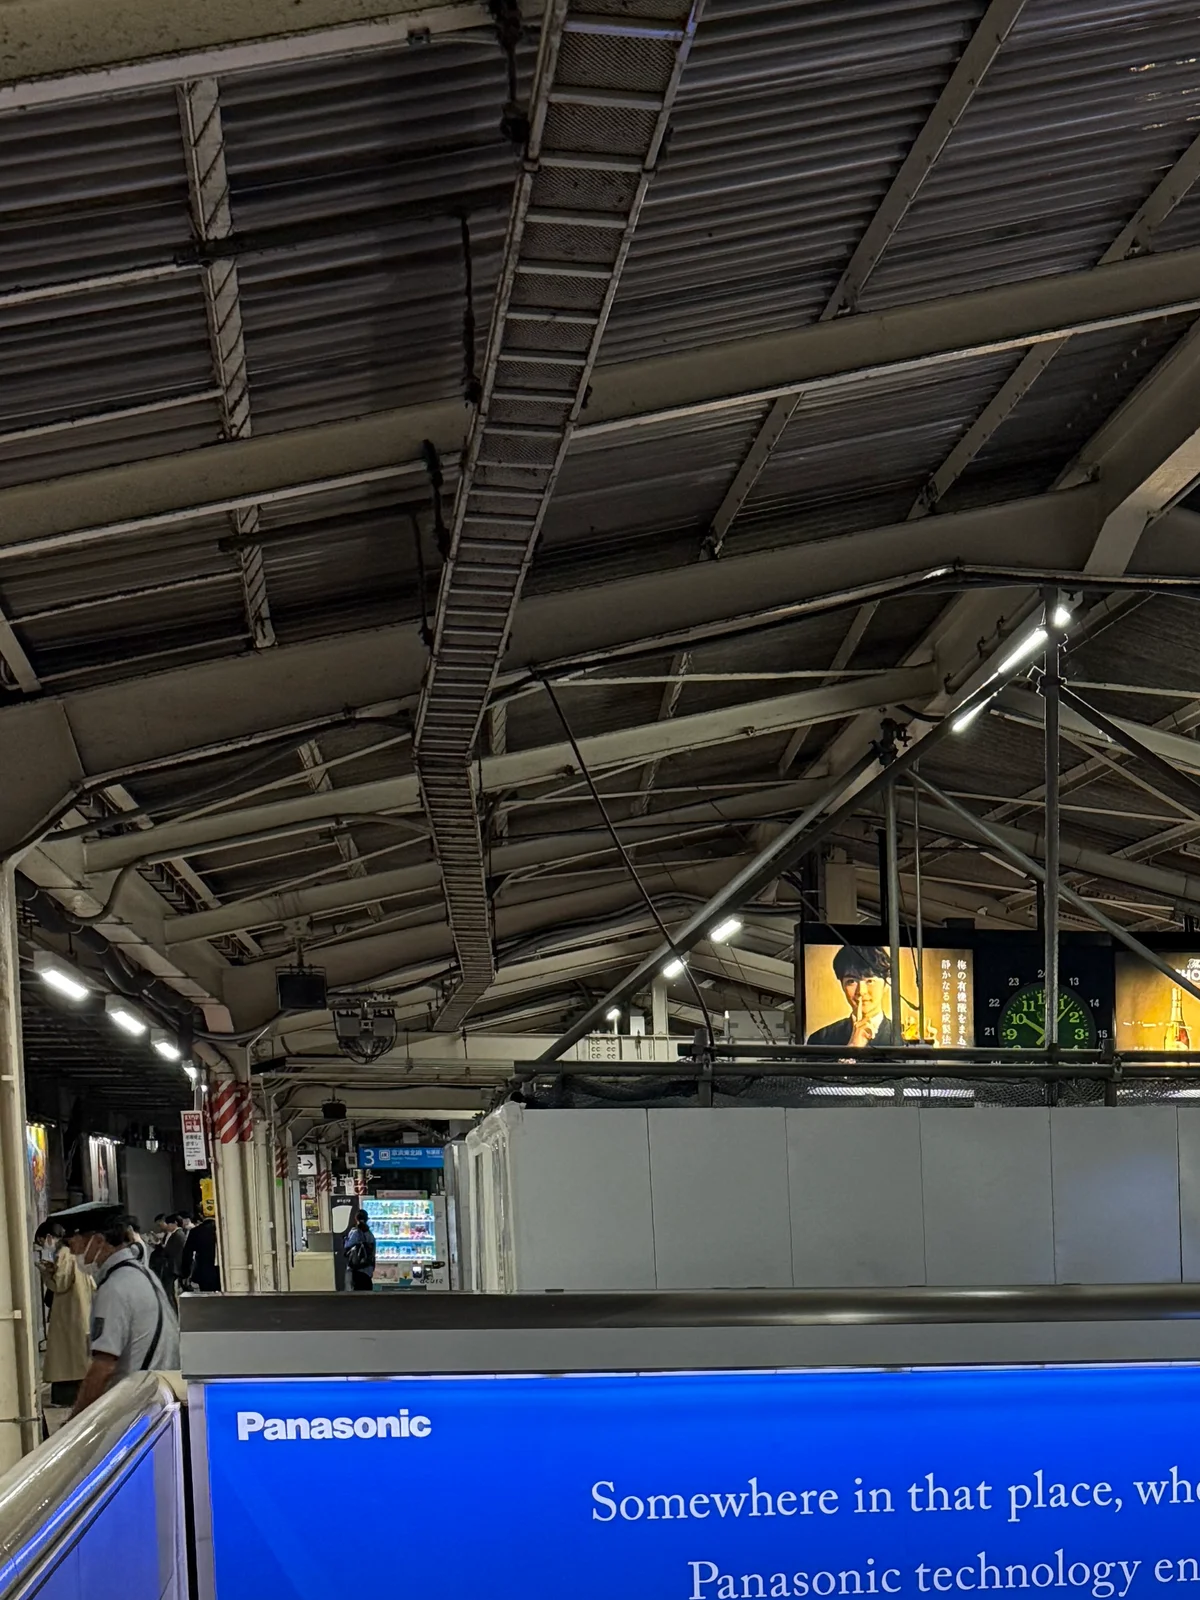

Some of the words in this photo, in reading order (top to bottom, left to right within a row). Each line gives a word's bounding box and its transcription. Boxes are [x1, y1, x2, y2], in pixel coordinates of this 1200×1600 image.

[1008, 977, 1019, 986] 23
[1069, 977, 1079, 986] 13
[989, 999, 1000, 1007] 22
[1022, 1000, 1036, 1011] 11
[1090, 999, 1099, 1007] 14
[1011, 1013, 1026, 1024] 10
[1069, 1012, 1080, 1023] 2
[984, 1027, 995, 1036] 21
[1006, 1028, 1018, 1040] 9
[1074, 1028, 1085, 1040] 3
[364, 1149, 375, 1166] 3
[237, 1408, 432, 1441] Panasonic
[591, 1476, 838, 1521] Somewhere
[854, 1478, 894, 1513] in
[908, 1473, 992, 1512] that
[1008, 1470, 1123, 1522] place,
[688, 1558, 901, 1600] Panasonic
[915, 1549, 1141, 1598] technology
